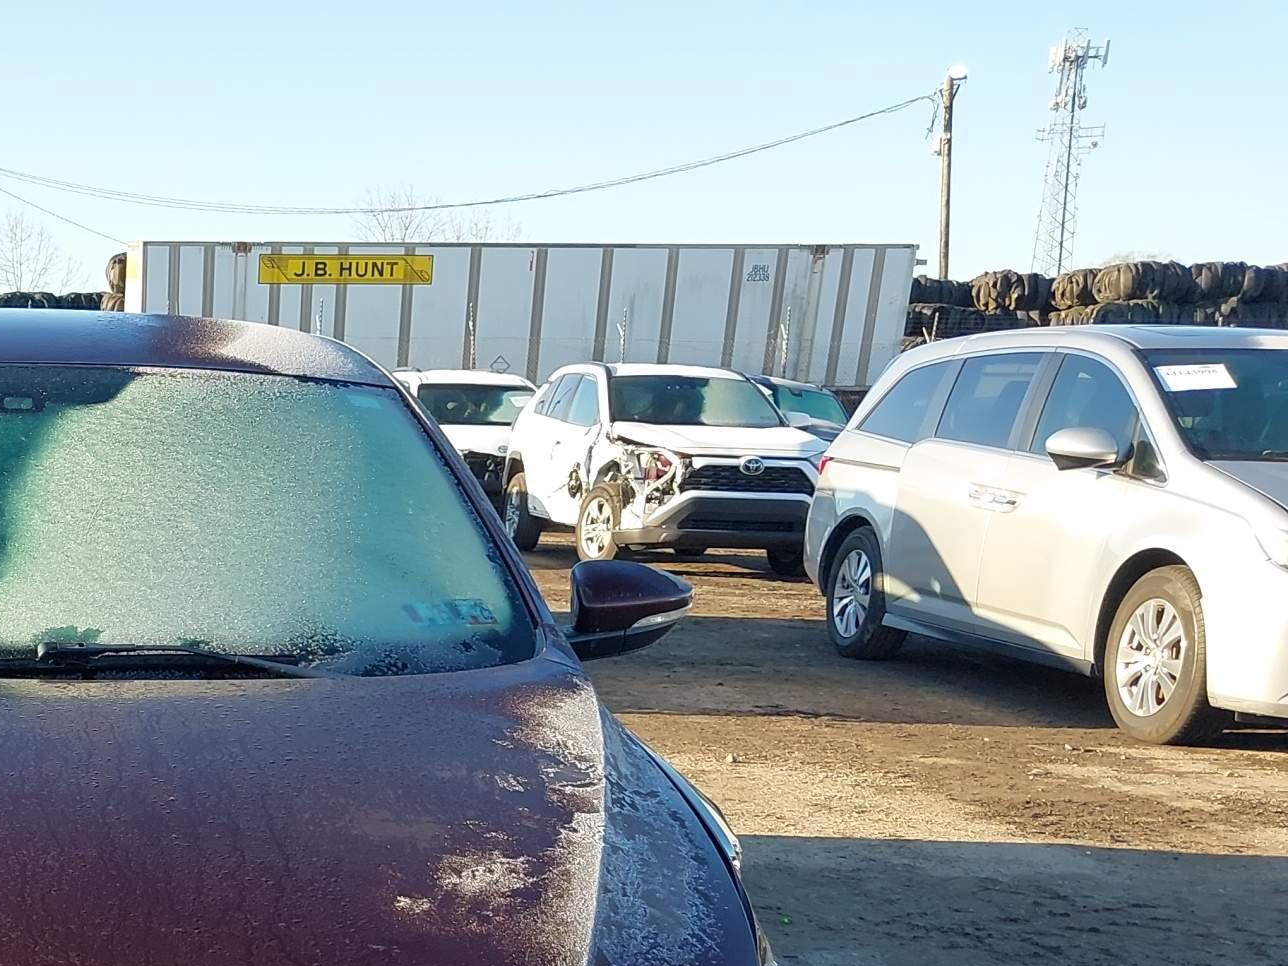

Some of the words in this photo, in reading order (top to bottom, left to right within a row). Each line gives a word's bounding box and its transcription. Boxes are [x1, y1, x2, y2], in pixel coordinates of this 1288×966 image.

[294, 261, 332, 278] J.B.
[339, 261, 399, 278] HUNT
[750, 264, 770, 274] JBHU
